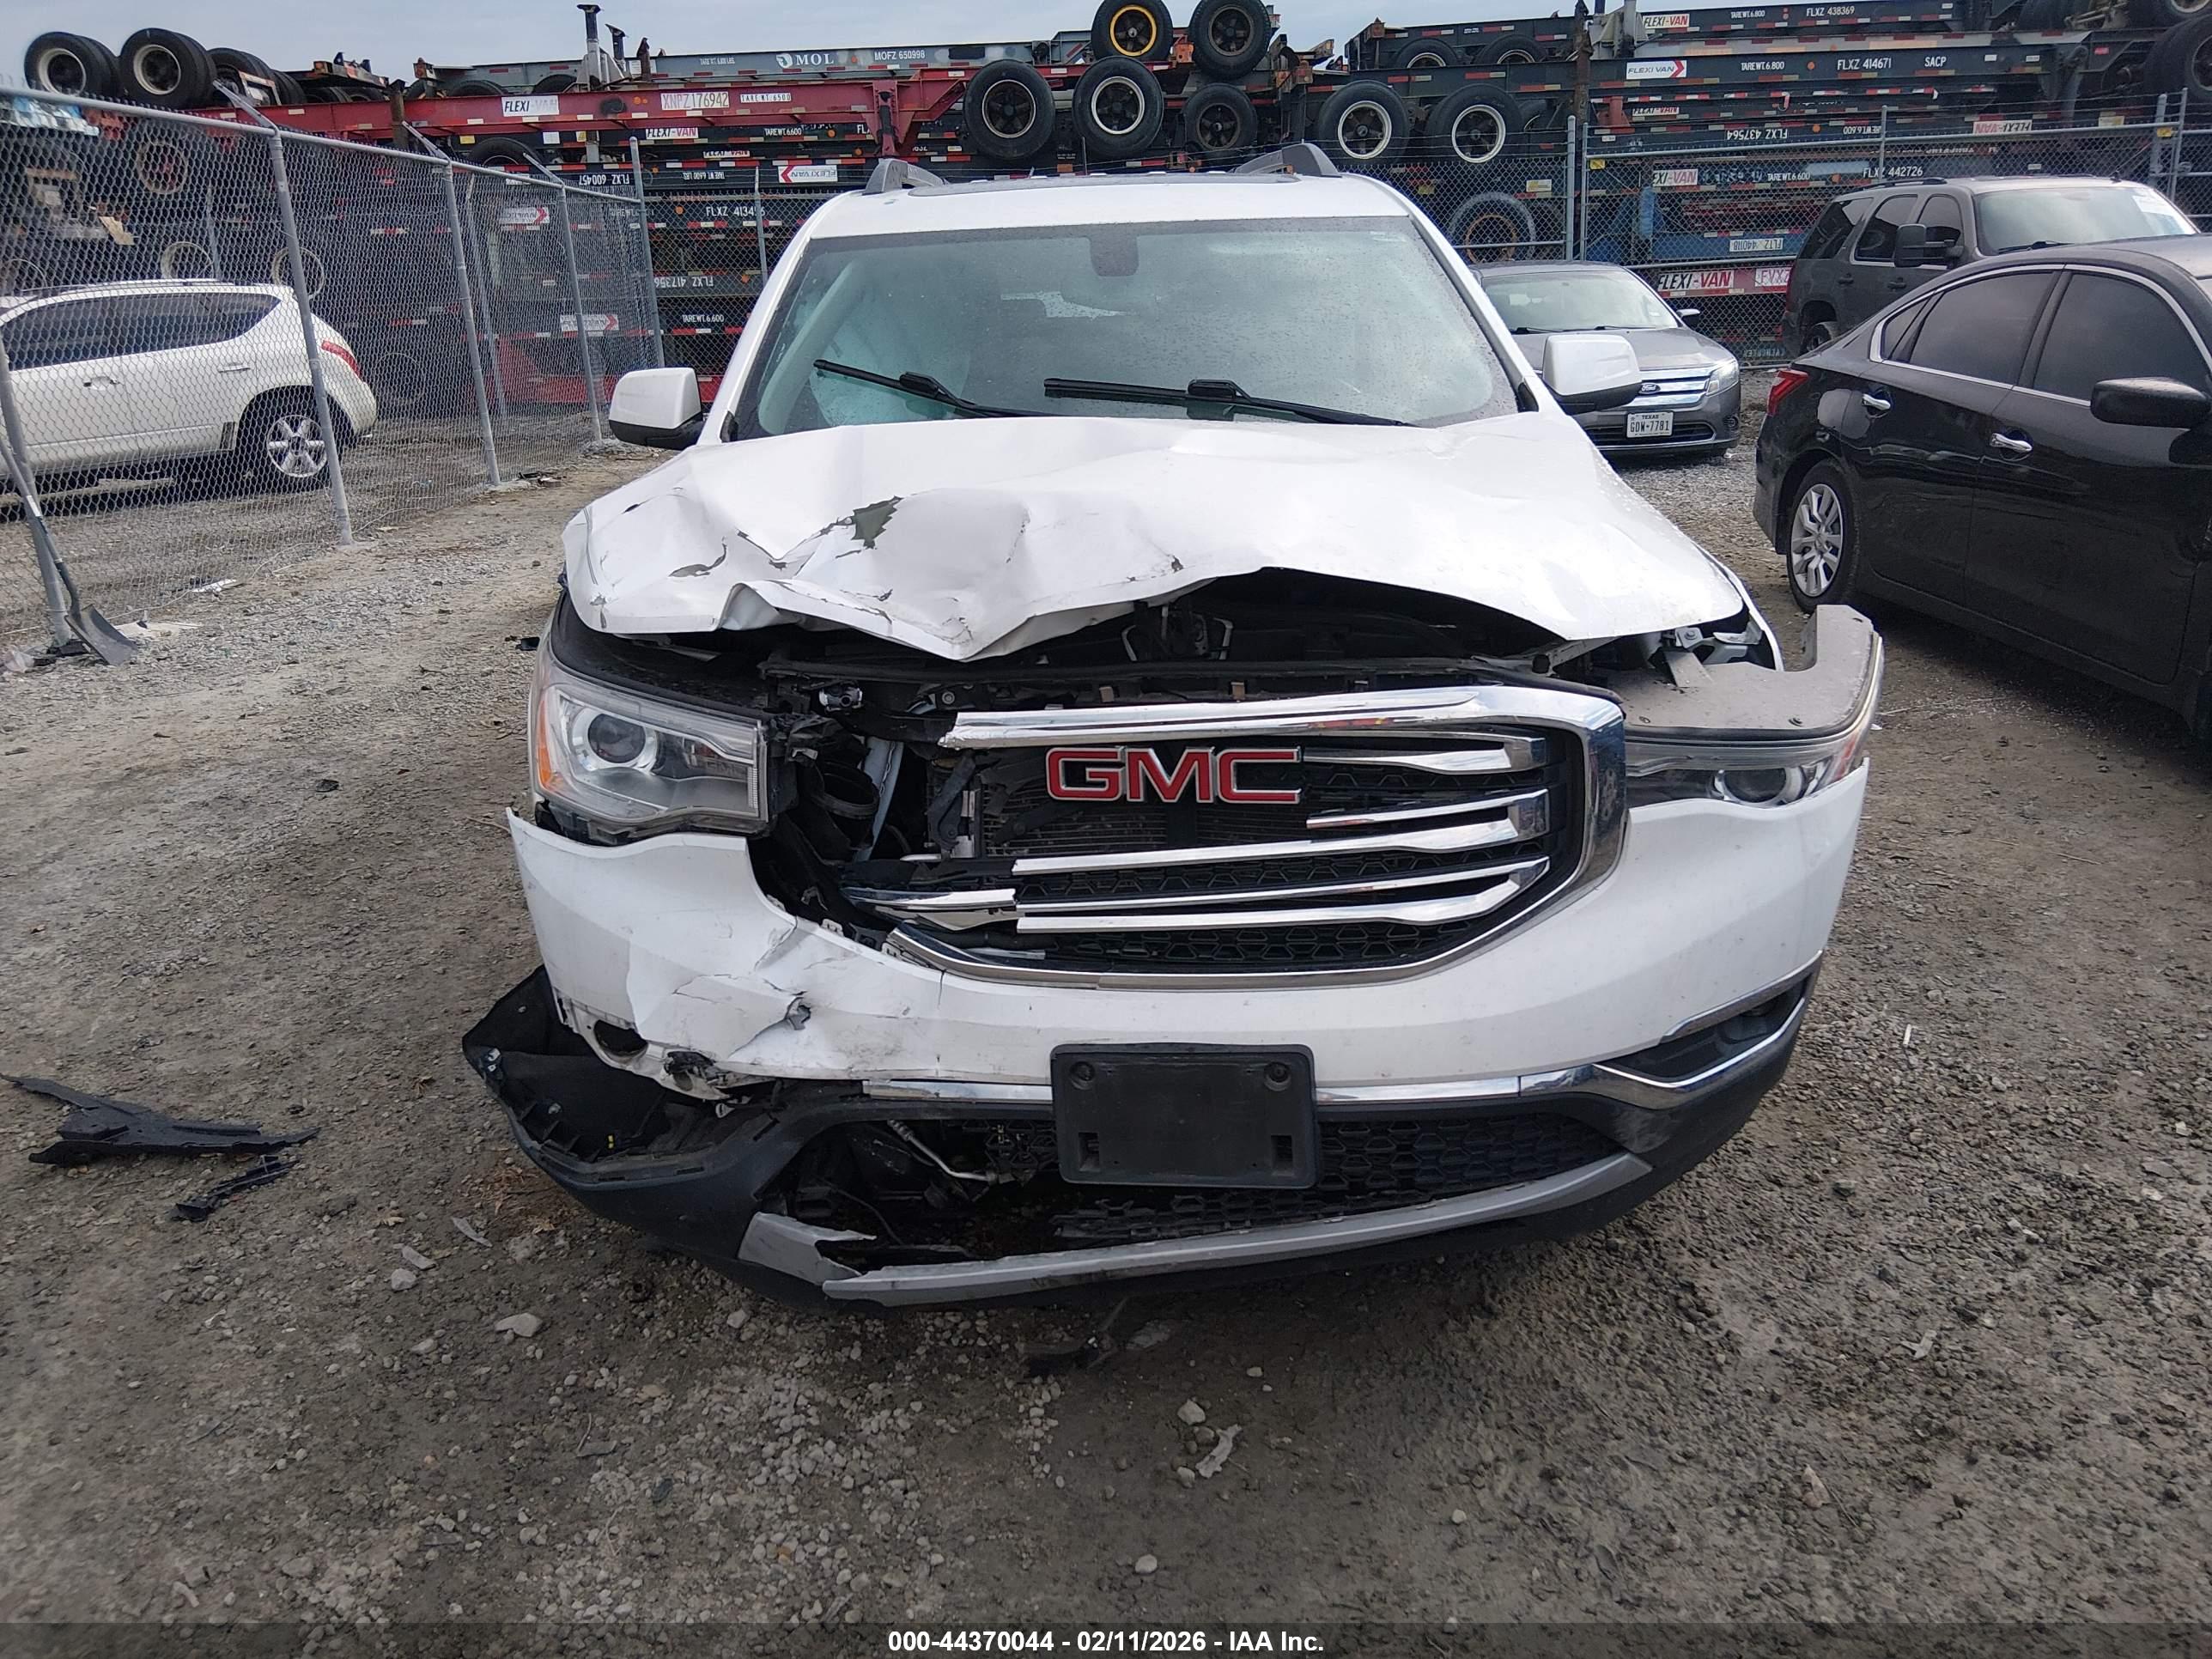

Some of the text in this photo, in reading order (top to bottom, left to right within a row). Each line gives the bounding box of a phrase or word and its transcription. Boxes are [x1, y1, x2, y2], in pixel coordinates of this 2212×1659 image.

[1806, 6, 1855, 17] FLXZ 438369
[1643, 15, 1688, 27] FLEXI-VAN
[796, 53, 835, 66] MOL
[874, 49, 926, 61] MOFZ 650998
[1837, 58, 1892, 70] FLXZ 414671
[1924, 56, 1947, 67] SACP
[1627, 66, 1655, 75] FLEXI
[1727, 128, 1788, 141] FLXZ 437564
[1887, 166, 1923, 177] 442726
[579, 173, 630, 185] FLXZ 600457
[706, 207, 729, 217] FLXZ
[654, 276, 714, 289] FLXZ 417356
[1658, 270, 1732, 290] FLEXI-VAN
[1046, 746, 1302, 805] GMC
